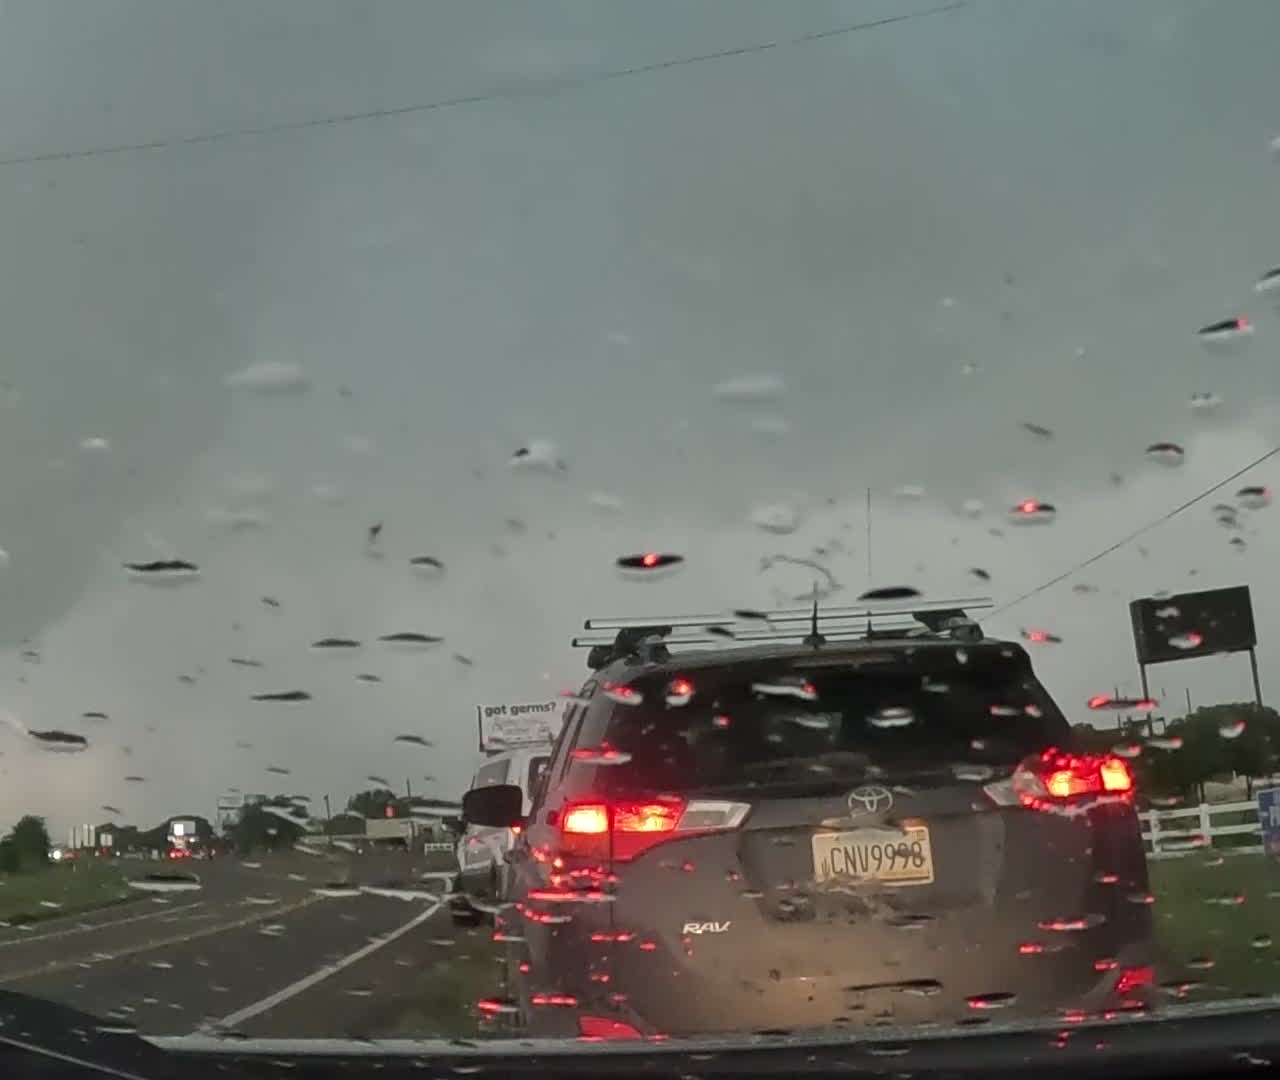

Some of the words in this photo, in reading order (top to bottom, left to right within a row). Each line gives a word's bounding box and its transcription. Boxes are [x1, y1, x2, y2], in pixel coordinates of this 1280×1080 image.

[485, 705, 507, 717] got
[510, 702, 556, 716] germs?
[830, 841, 925, 875] CNV9998
